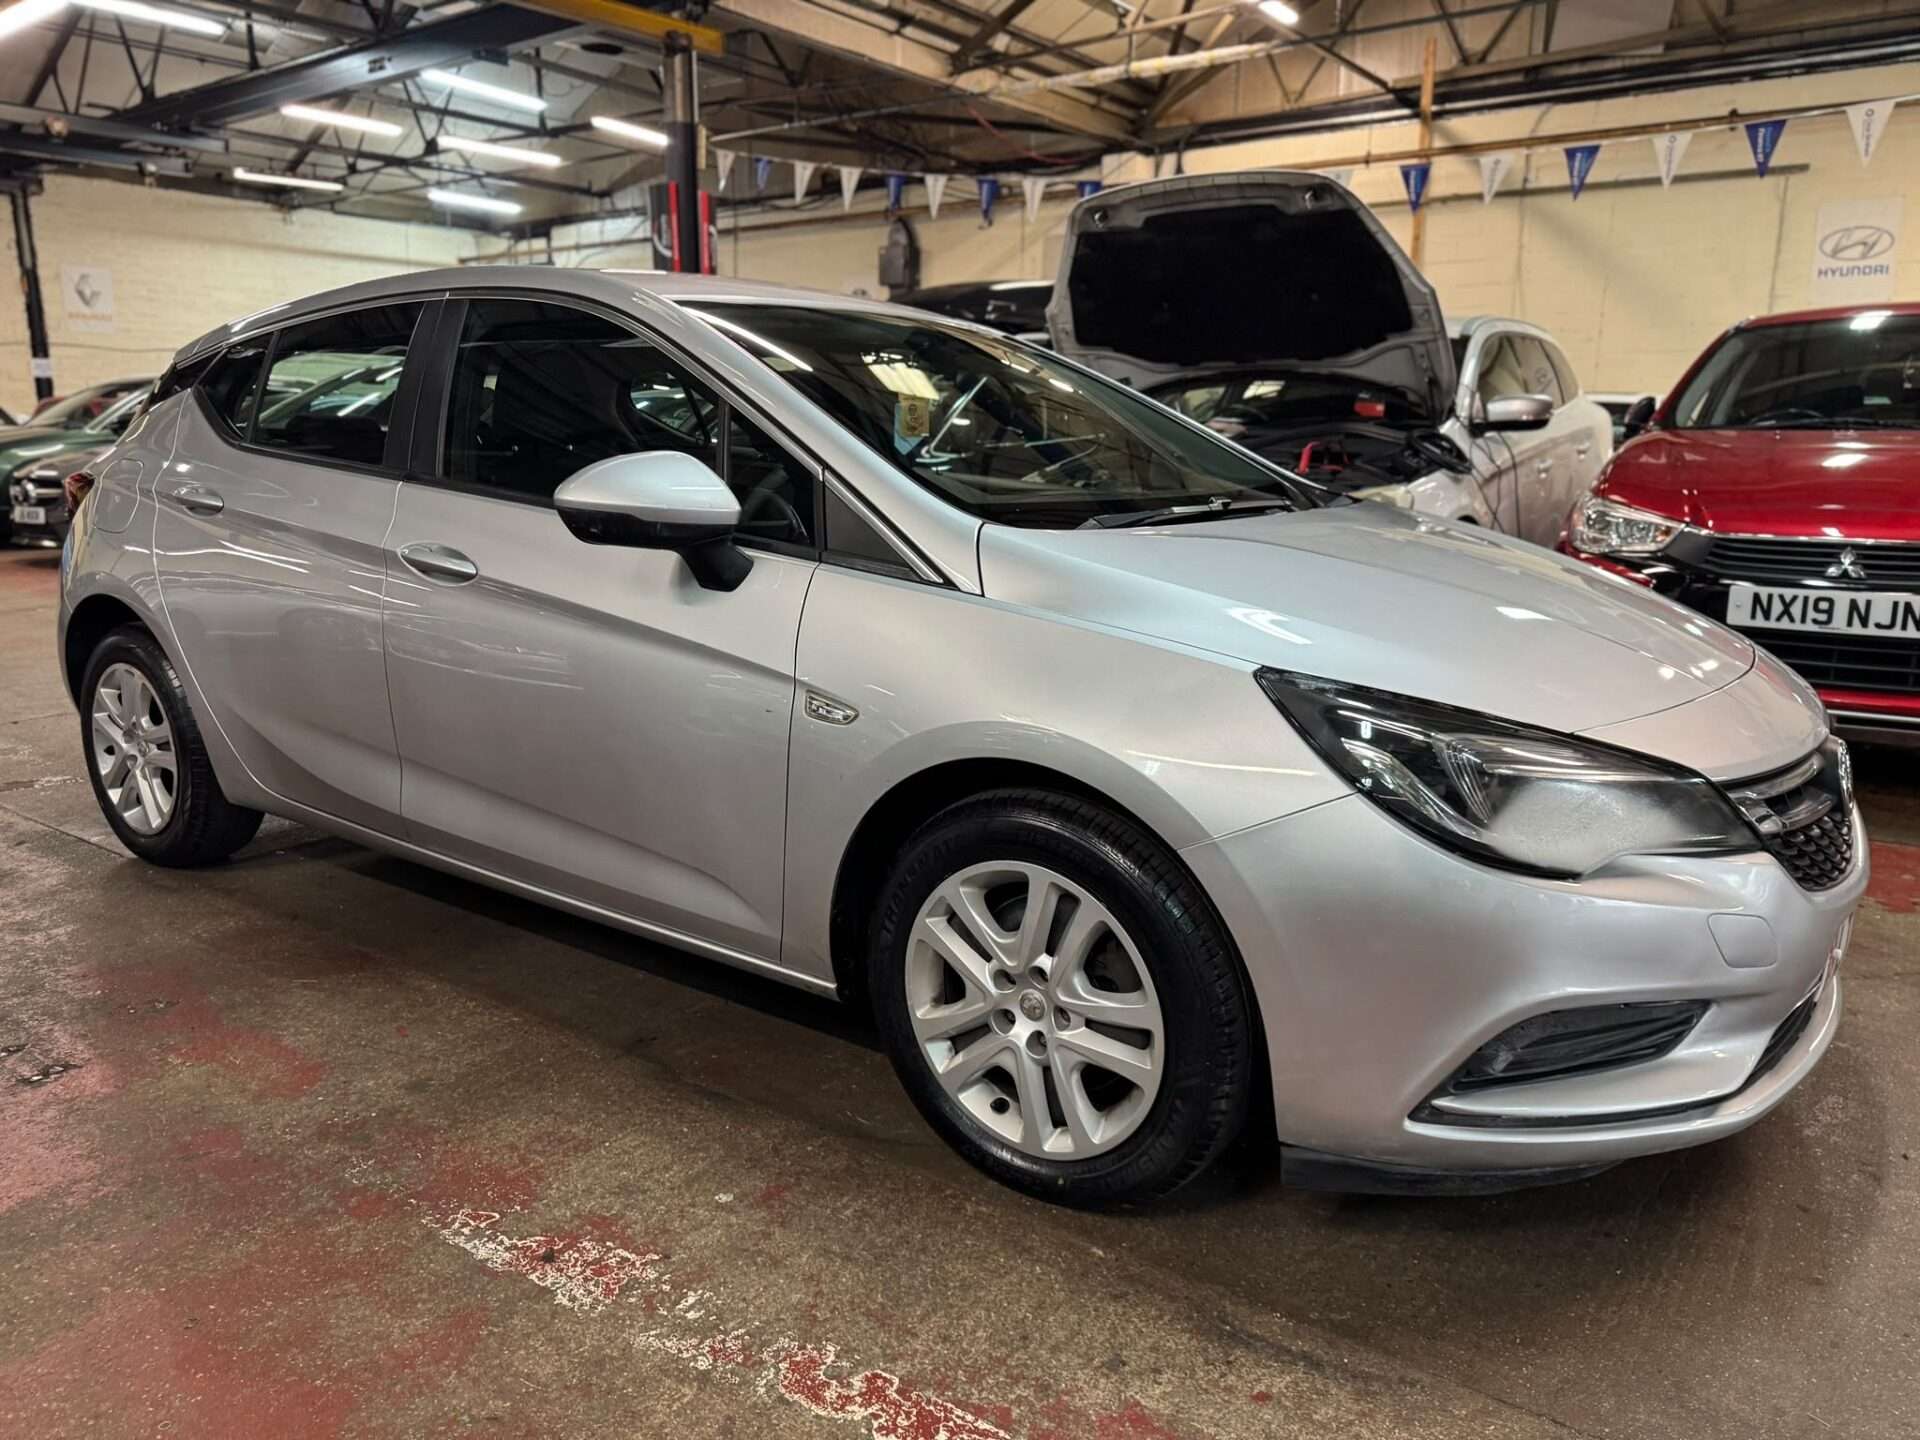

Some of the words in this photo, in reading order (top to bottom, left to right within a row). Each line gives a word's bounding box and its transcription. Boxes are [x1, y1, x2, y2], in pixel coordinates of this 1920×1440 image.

[1817, 264, 1889, 279] HYUNDAI
[1750, 592, 1835, 626] NX19
[1846, 599, 1920, 632] NJN
